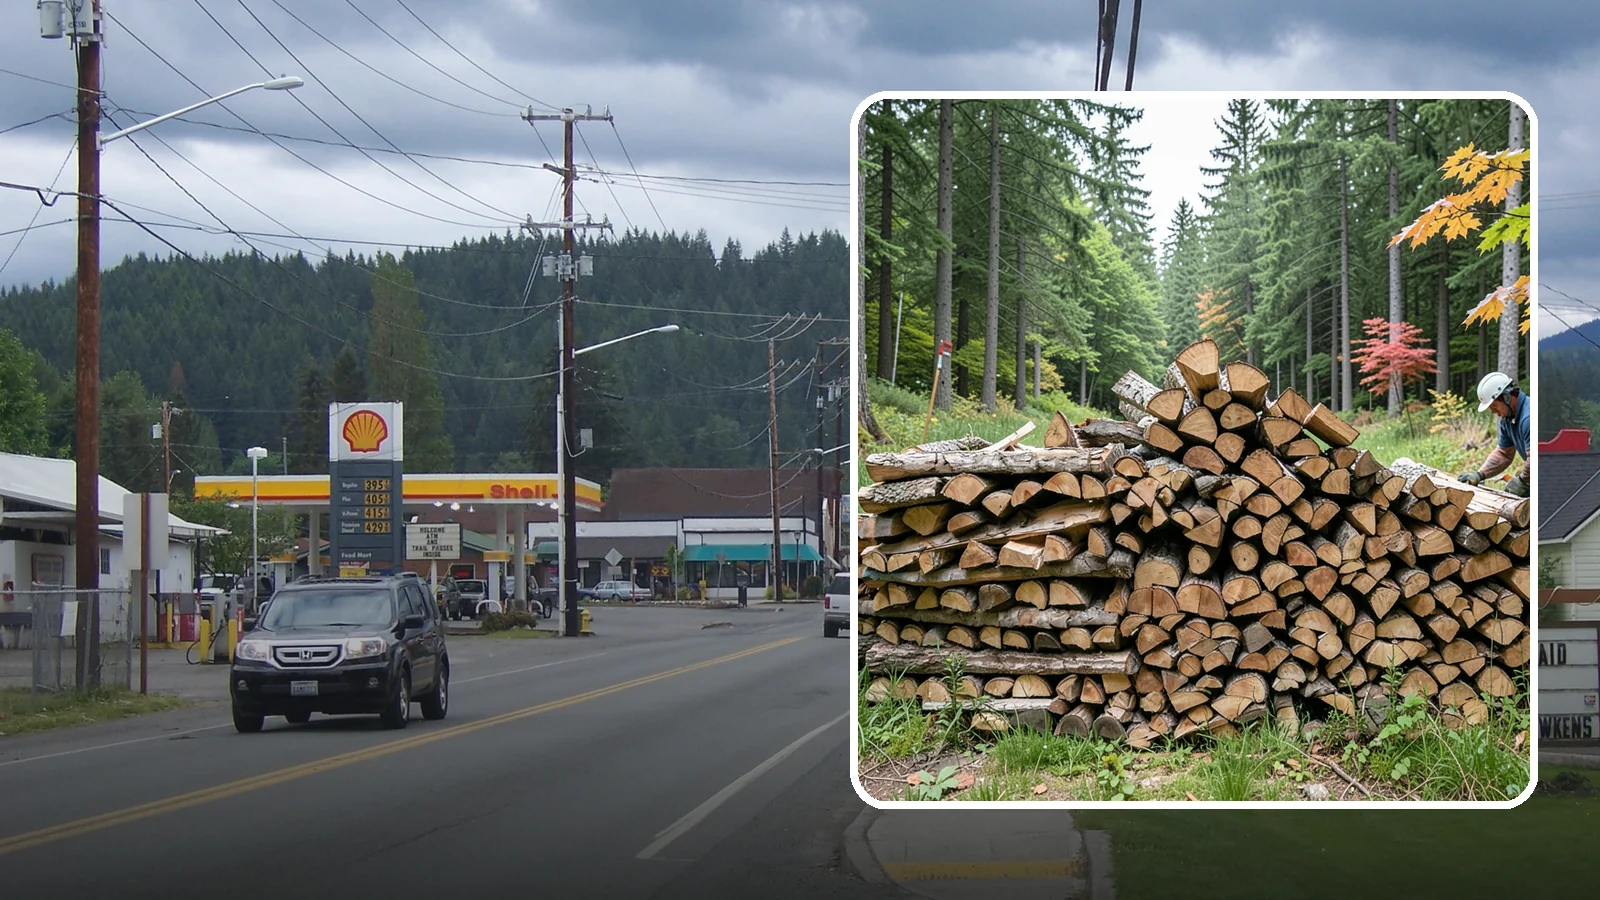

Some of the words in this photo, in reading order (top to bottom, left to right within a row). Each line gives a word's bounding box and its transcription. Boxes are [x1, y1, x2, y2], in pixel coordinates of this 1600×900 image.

[365, 480, 383, 490] 395
[490, 484, 547, 499] Shell
[365, 494, 383, 504] 405
[365, 508, 383, 518] 415
[365, 522, 383, 532] 429
